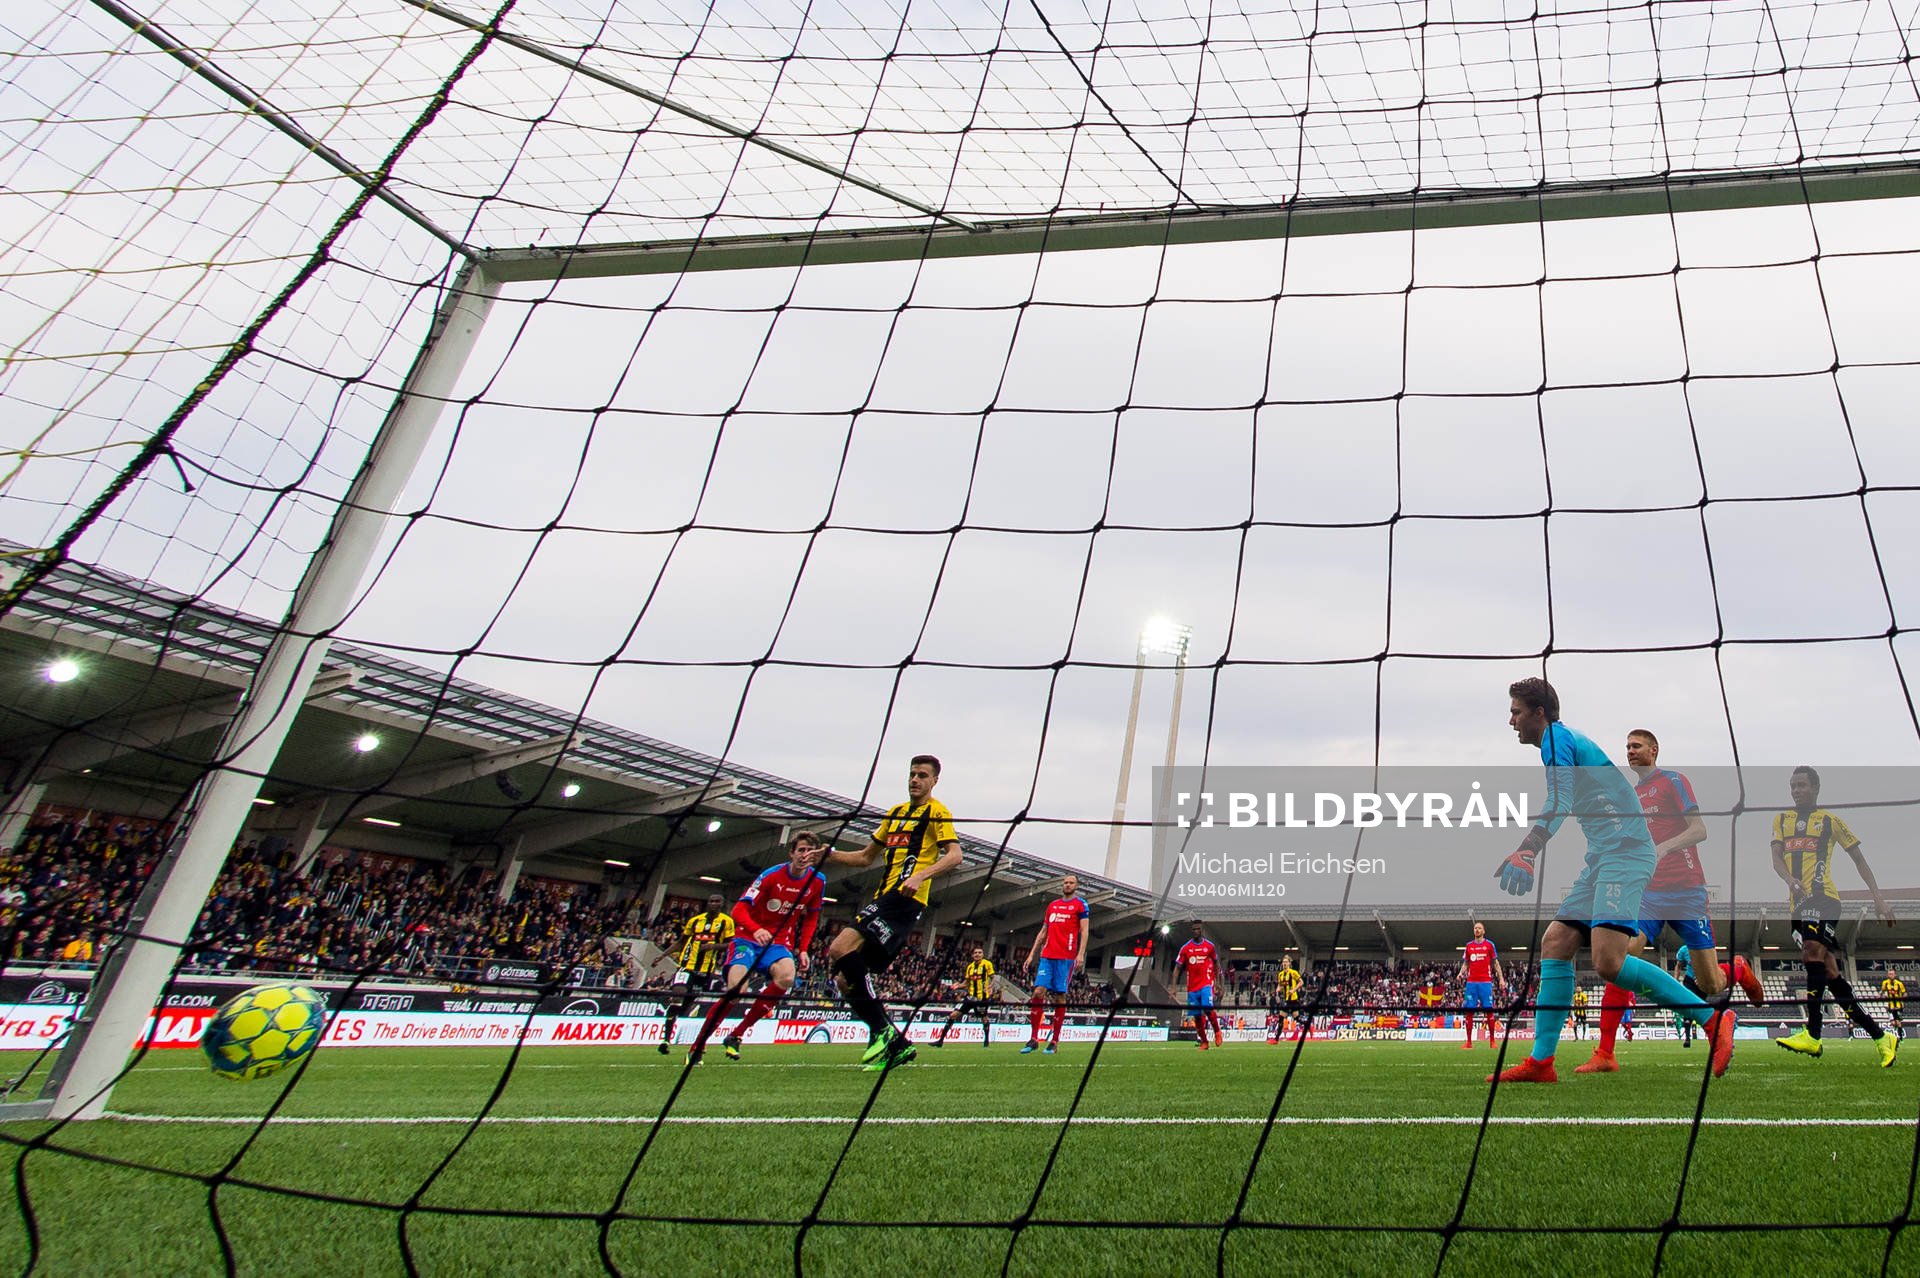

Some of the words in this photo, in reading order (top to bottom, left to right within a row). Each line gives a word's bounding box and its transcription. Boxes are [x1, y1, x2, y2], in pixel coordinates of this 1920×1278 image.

[1605, 883, 1621, 897] 25
[501, 967, 539, 979] GÖTEBORG
[39, 1015, 64, 1037] 5
[373, 1023, 400, 1039] The
[401, 1023, 438, 1039] Drive
[439, 1024, 486, 1039] Behind
[486, 1024, 510, 1039] The
[511, 1024, 543, 1039] Team
[551, 1023, 625, 1040] MAXXIS
[1358, 1030, 1406, 1040] XL-BYGG
